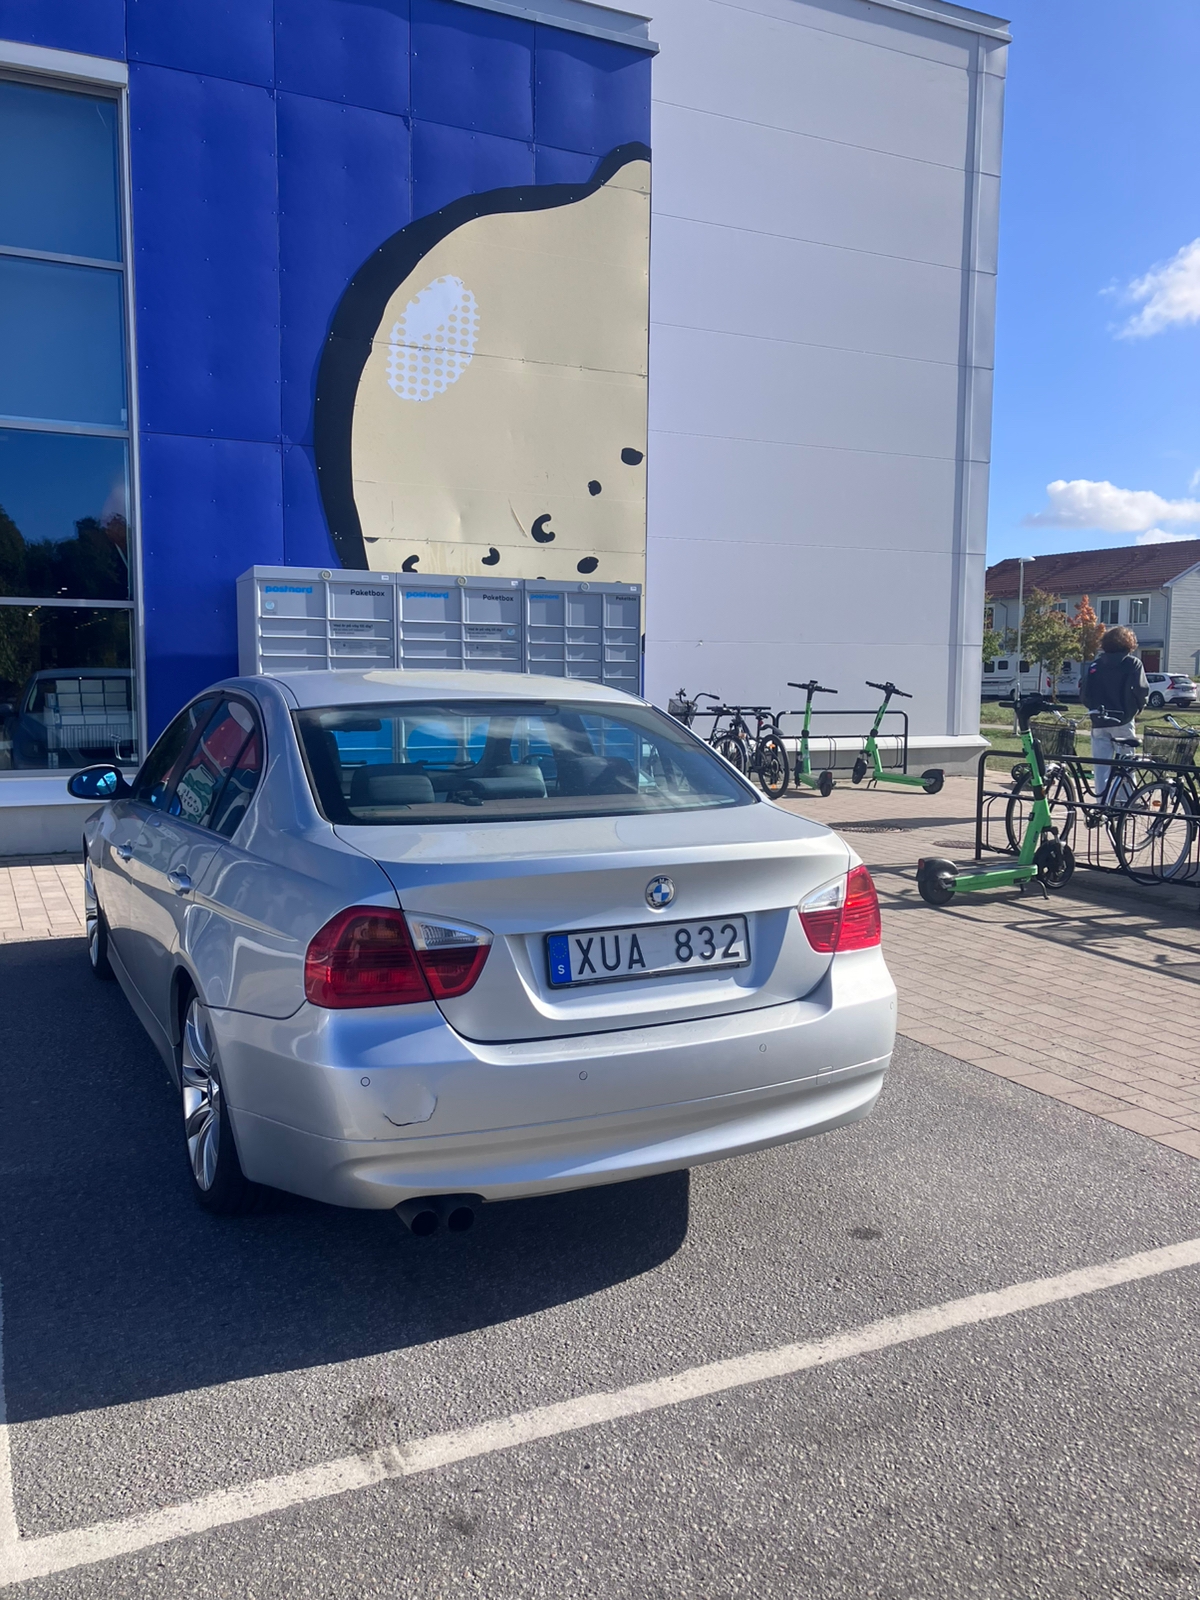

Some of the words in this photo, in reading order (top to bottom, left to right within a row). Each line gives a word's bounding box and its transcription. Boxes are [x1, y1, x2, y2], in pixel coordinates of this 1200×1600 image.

[265, 586, 313, 594] postnord
[350, 589, 385, 597] Paketbox
[405, 591, 449, 599] postnord
[482, 594, 514, 602] Paketbox
[575, 933, 647, 975] XUA
[675, 923, 740, 962] 832
[557, 964, 566, 975] S
